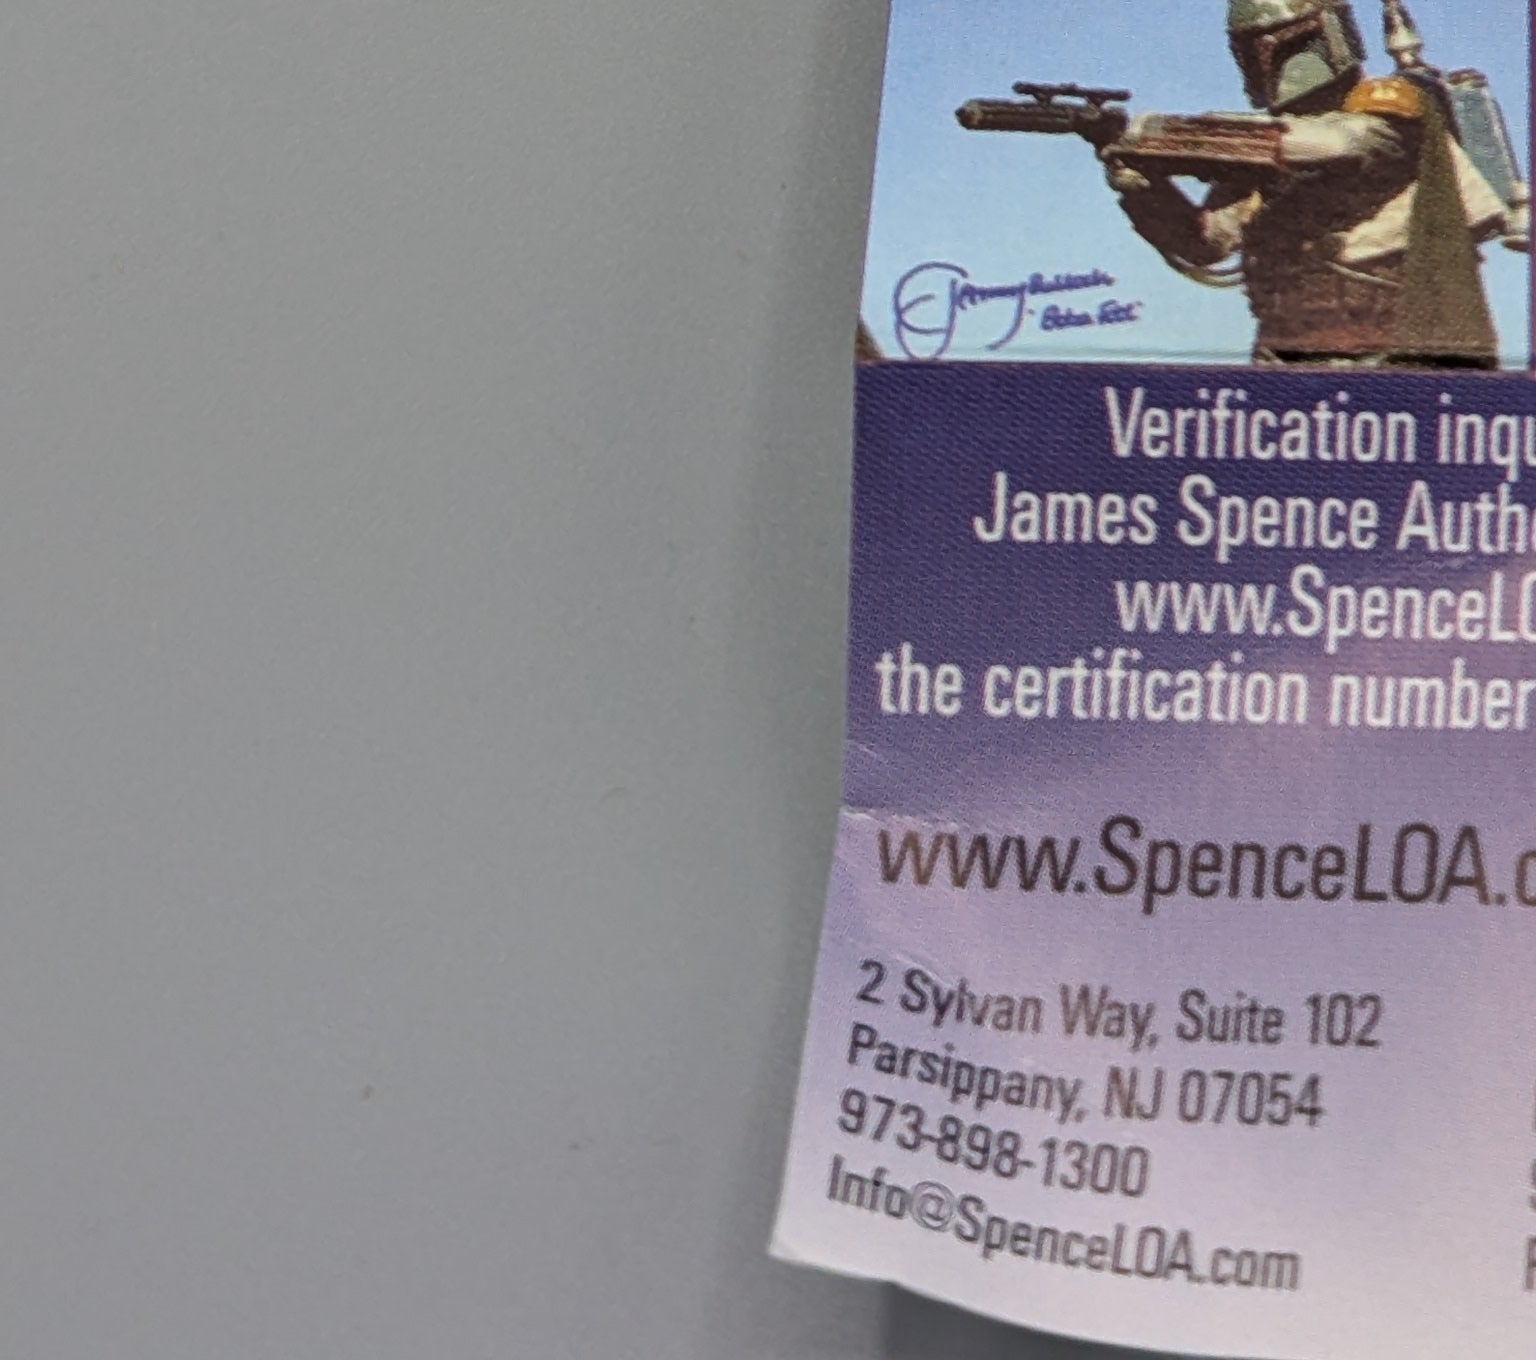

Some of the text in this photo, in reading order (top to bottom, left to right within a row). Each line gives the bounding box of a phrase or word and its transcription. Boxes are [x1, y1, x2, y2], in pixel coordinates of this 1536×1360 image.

[1104, 385, 1416, 463] Verification
[972, 470, 1158, 545] James
[1176, 473, 1379, 563] Spence
[876, 641, 963, 717] the
[983, 645, 1308, 725] certification
[856, 958, 1383, 1051] 2 Sylvan Way, Suite 102
[847, 1023, 1325, 1127] Parsippany, NJ 07054
[837, 1087, 1150, 1198] 973-898-1300
[826, 1154, 1301, 1291] Info@SpenceLOA.com
